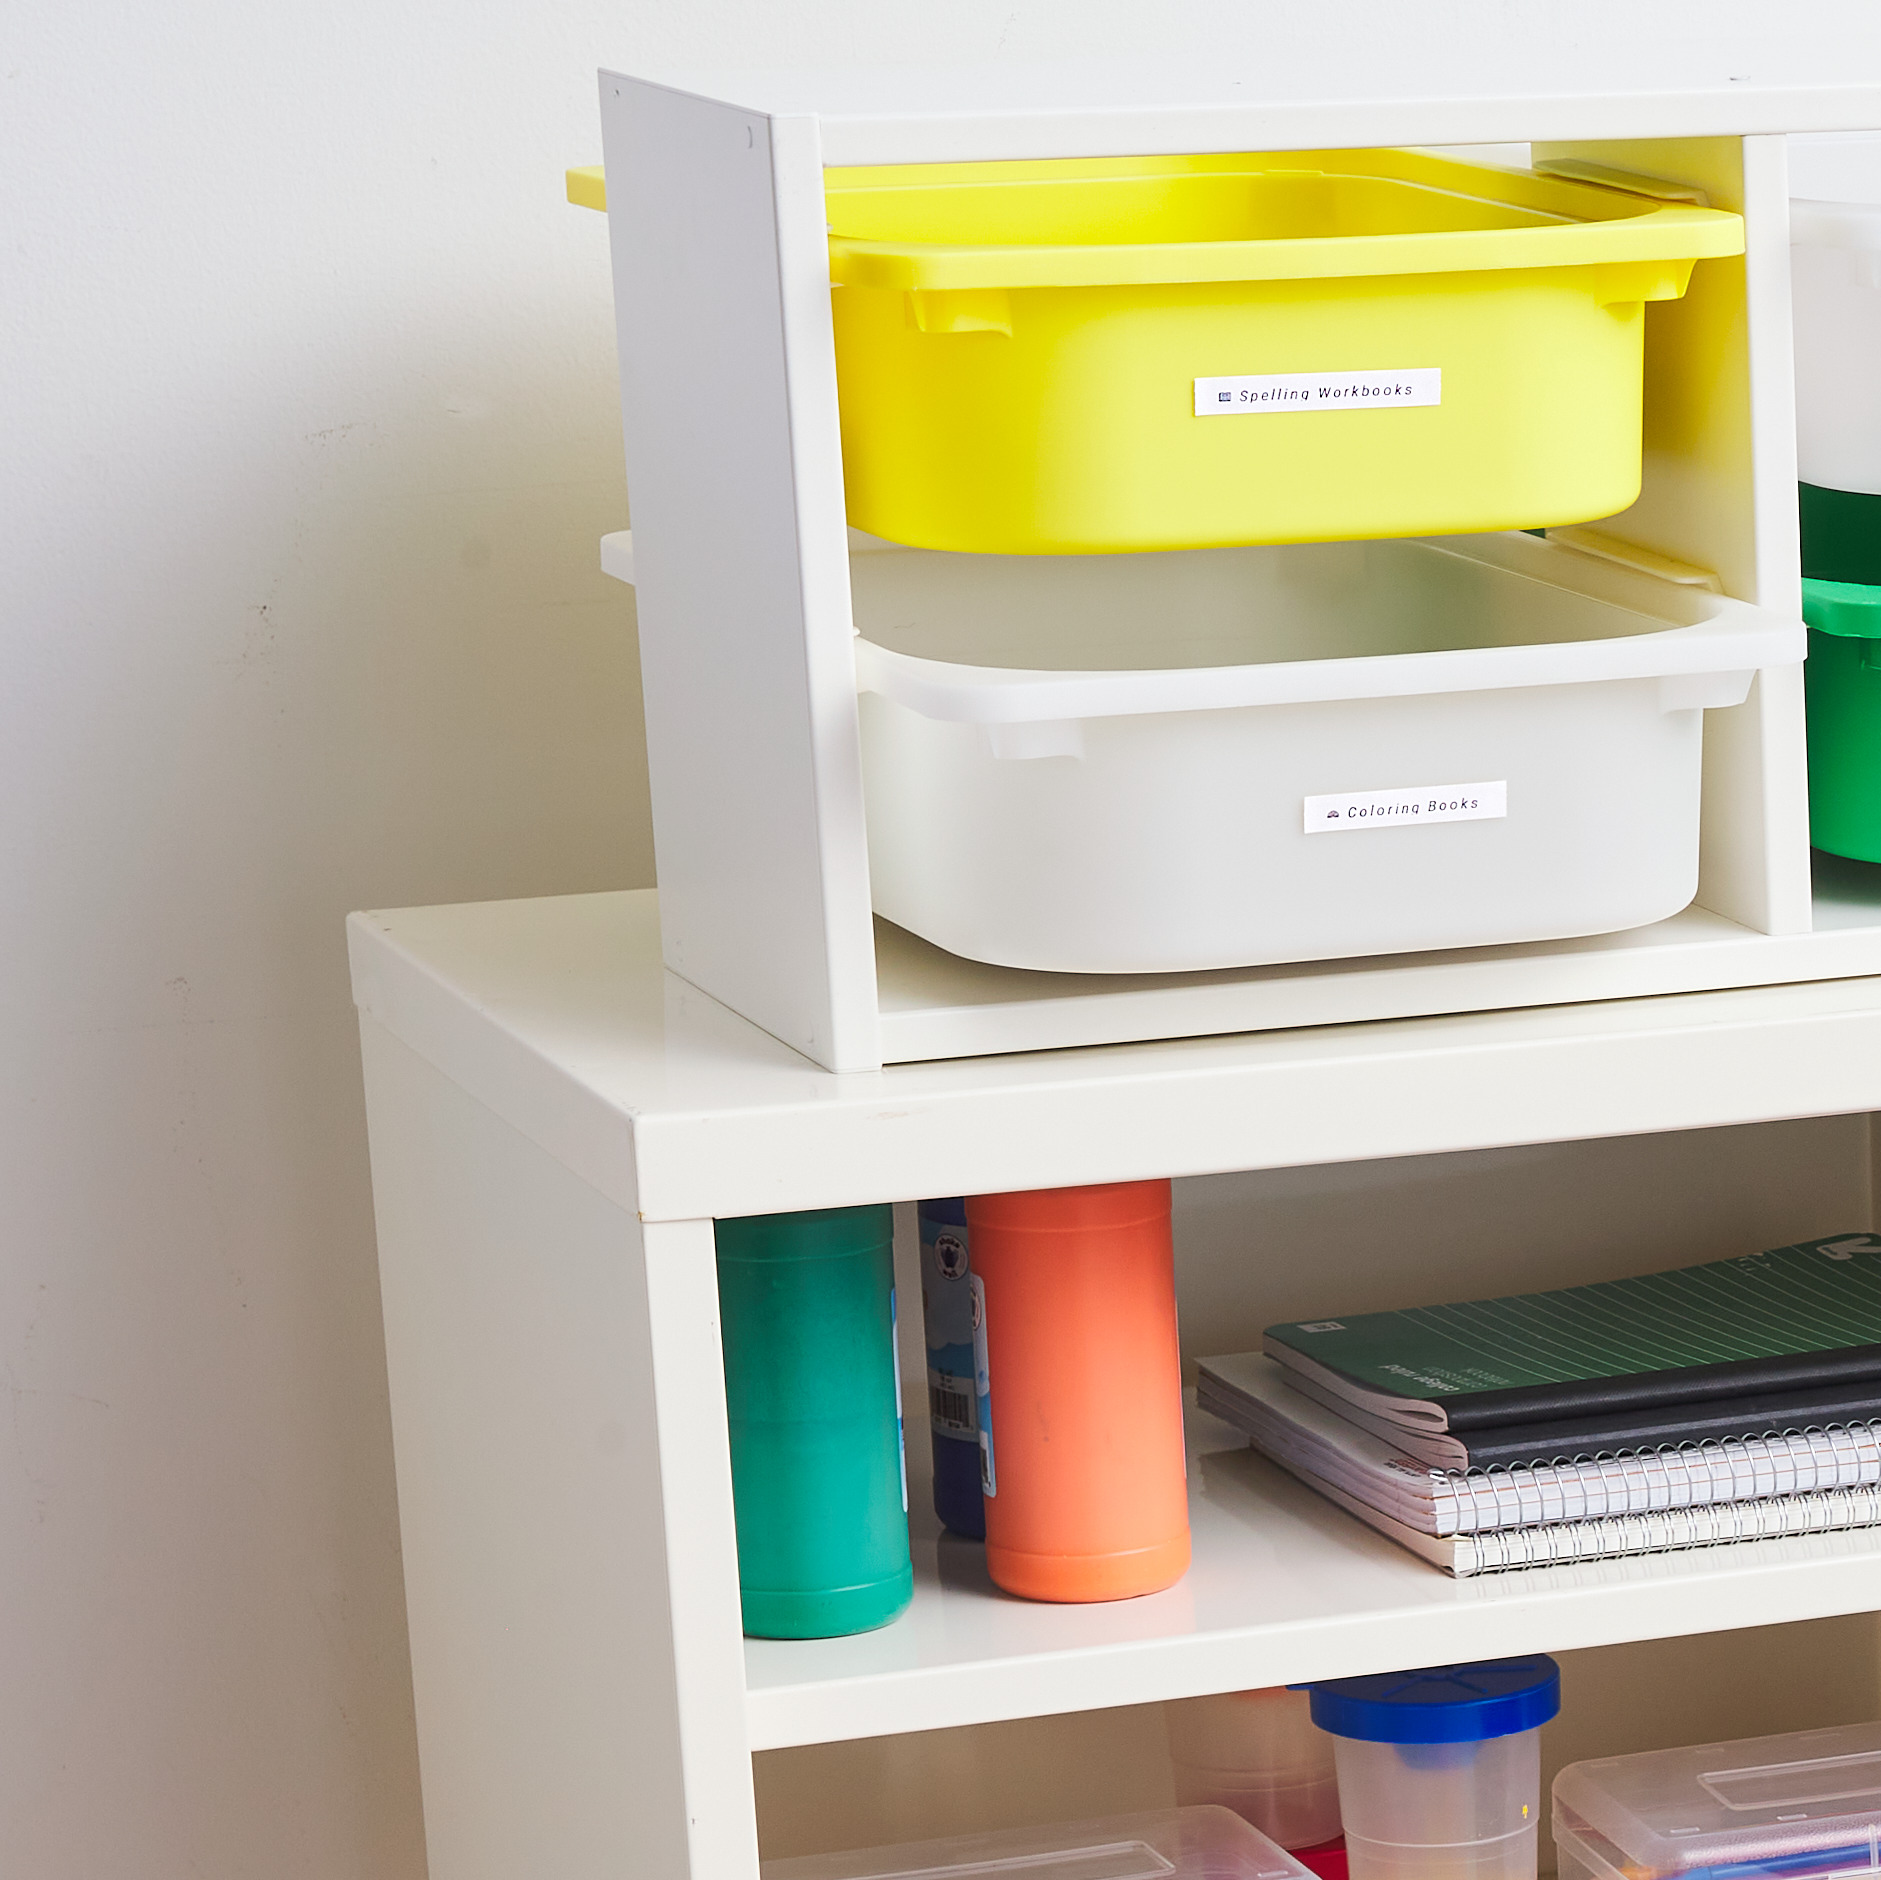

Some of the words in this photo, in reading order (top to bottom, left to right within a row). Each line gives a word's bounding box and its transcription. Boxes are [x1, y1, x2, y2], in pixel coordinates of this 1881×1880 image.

[1239, 387, 1310, 404] Spelling
[1318, 383, 1414, 399] Workbooks
[1347, 802, 1421, 819] Coloring
[1427, 797, 1480, 813] Books
